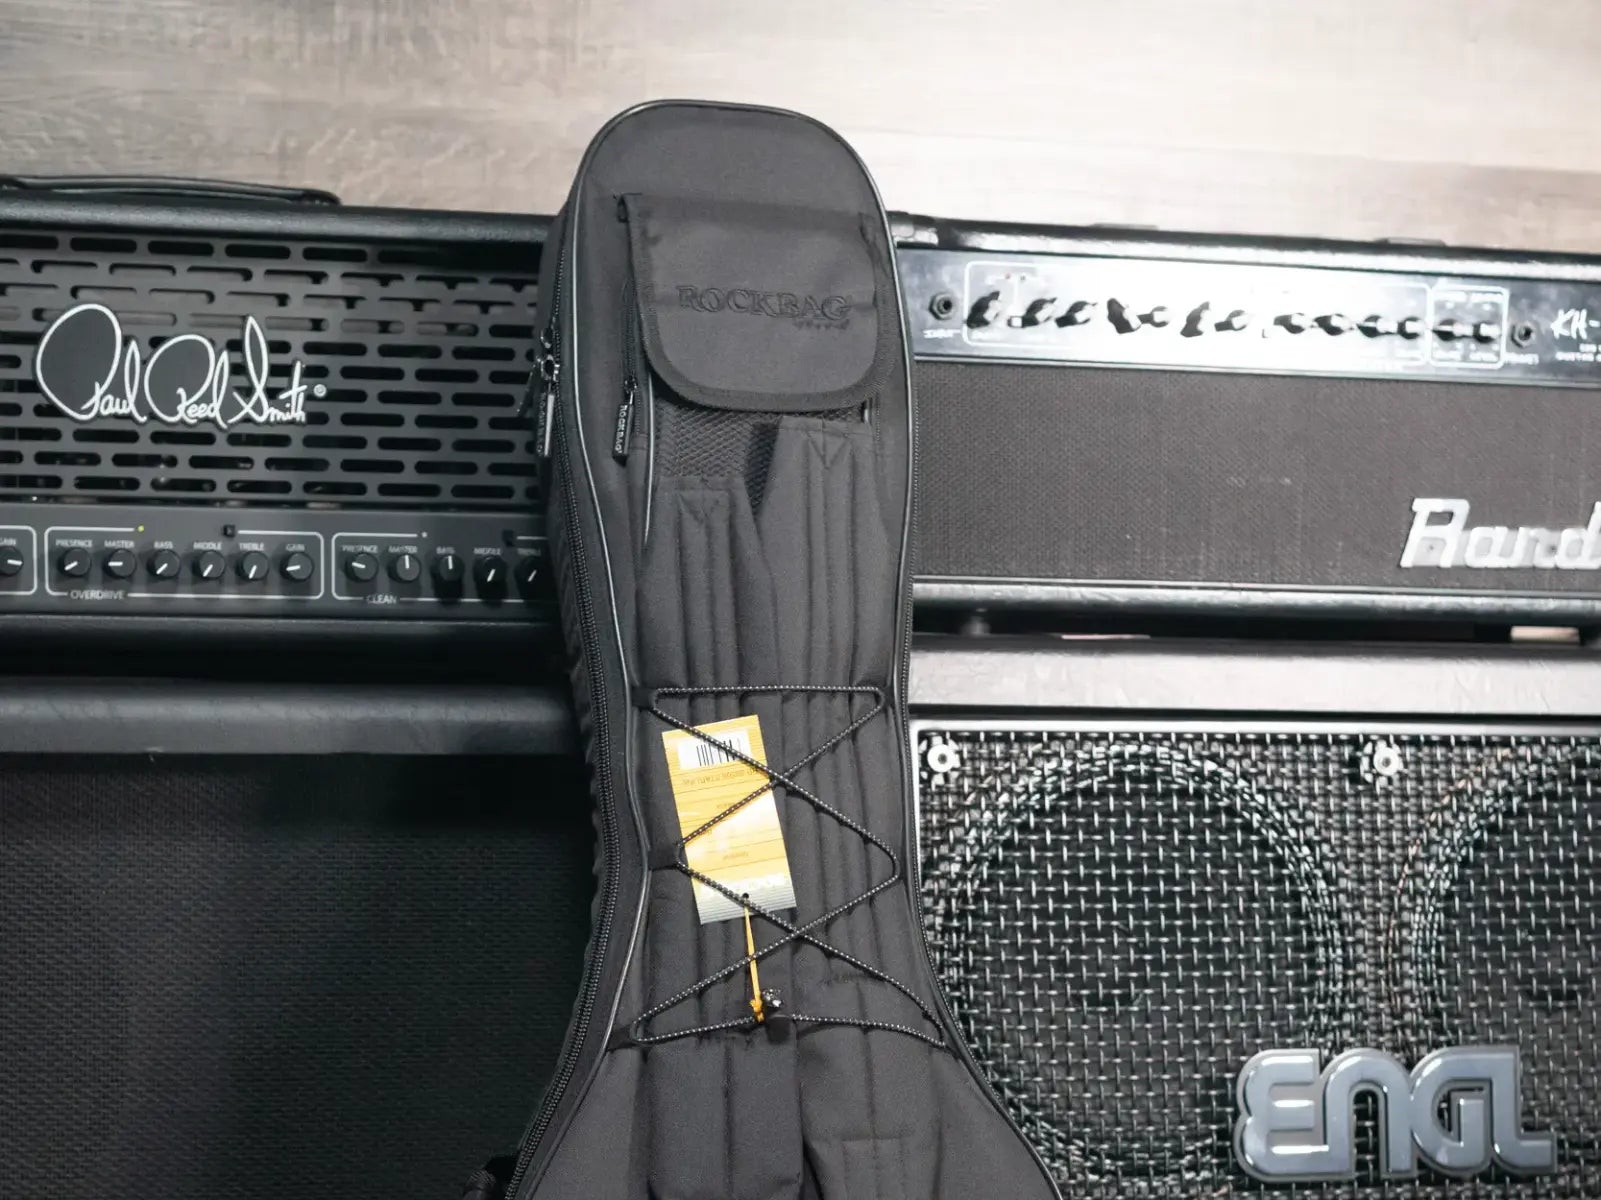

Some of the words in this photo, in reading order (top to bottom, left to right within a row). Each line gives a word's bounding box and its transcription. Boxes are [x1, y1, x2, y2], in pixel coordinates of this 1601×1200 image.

[675, 285, 851, 321] ROCKBAG
[36, 303, 147, 424] Paul
[144, 334, 230, 430] Reed
[228, 316, 307, 424] Smith
[55, 538, 93, 548] PRESENCE
[104, 539, 135, 549] MASTER
[154, 540, 174, 550] BASS
[238, 541, 265, 551] TREBLE
[70, 589, 125, 601] OVERDRIVE
[366, 594, 398, 605] CLEAN
